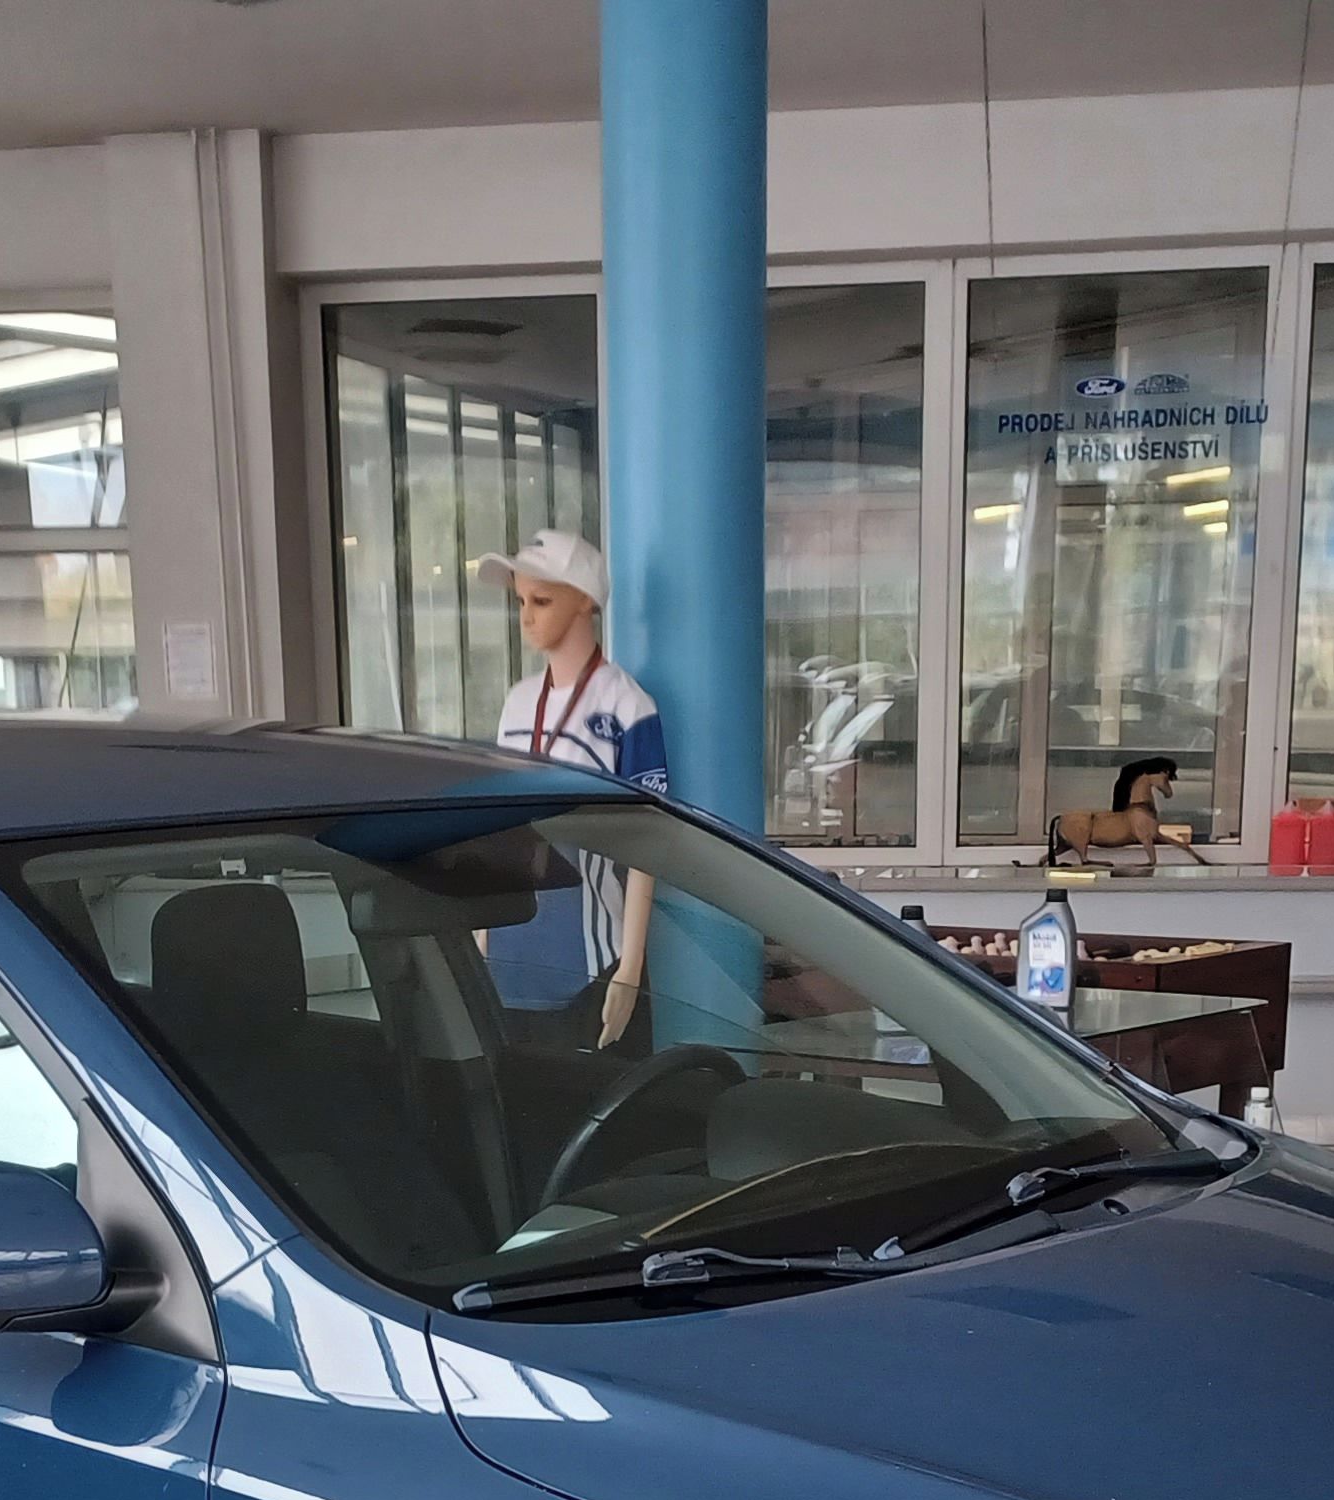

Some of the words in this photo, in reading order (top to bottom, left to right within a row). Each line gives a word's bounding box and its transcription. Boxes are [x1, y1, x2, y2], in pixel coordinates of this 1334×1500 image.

[1081, 378, 1121, 396] Ford
[997, 413, 1074, 434] PRODEJ
[1044, 445, 1057, 465] A
